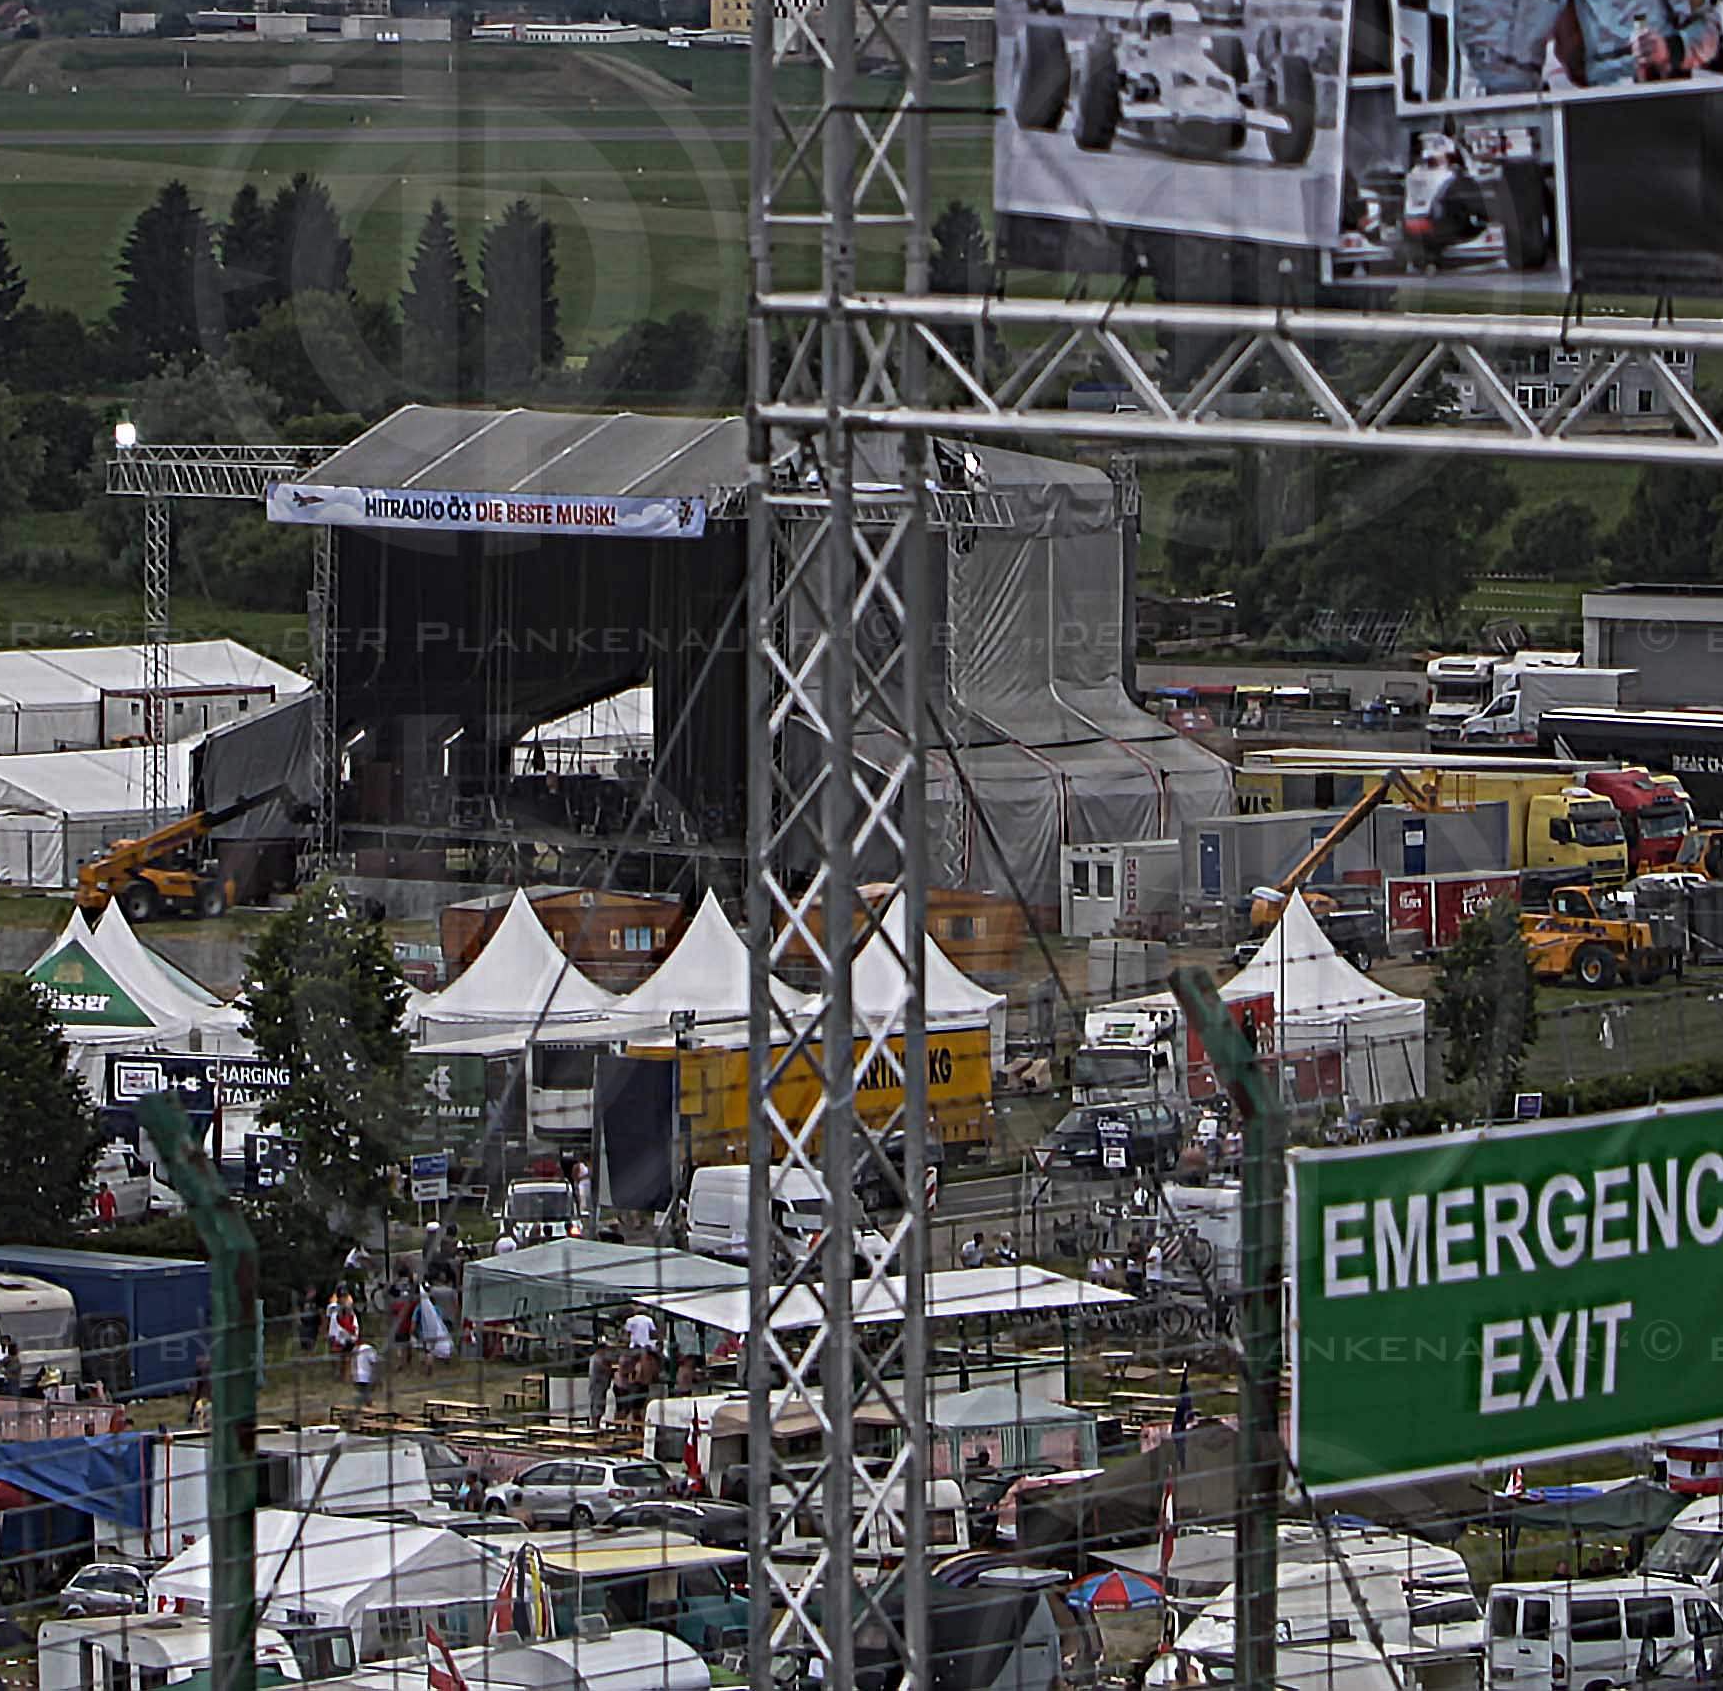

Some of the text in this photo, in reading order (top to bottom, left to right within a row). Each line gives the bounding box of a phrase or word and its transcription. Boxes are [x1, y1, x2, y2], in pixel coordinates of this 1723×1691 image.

[364, 495, 617, 527] HITRADIO Ö3 DIE BESTE MUSIK!
[205, 1065, 291, 1085] CHARGING
[1479, 1301, 1632, 1415] EXIT
